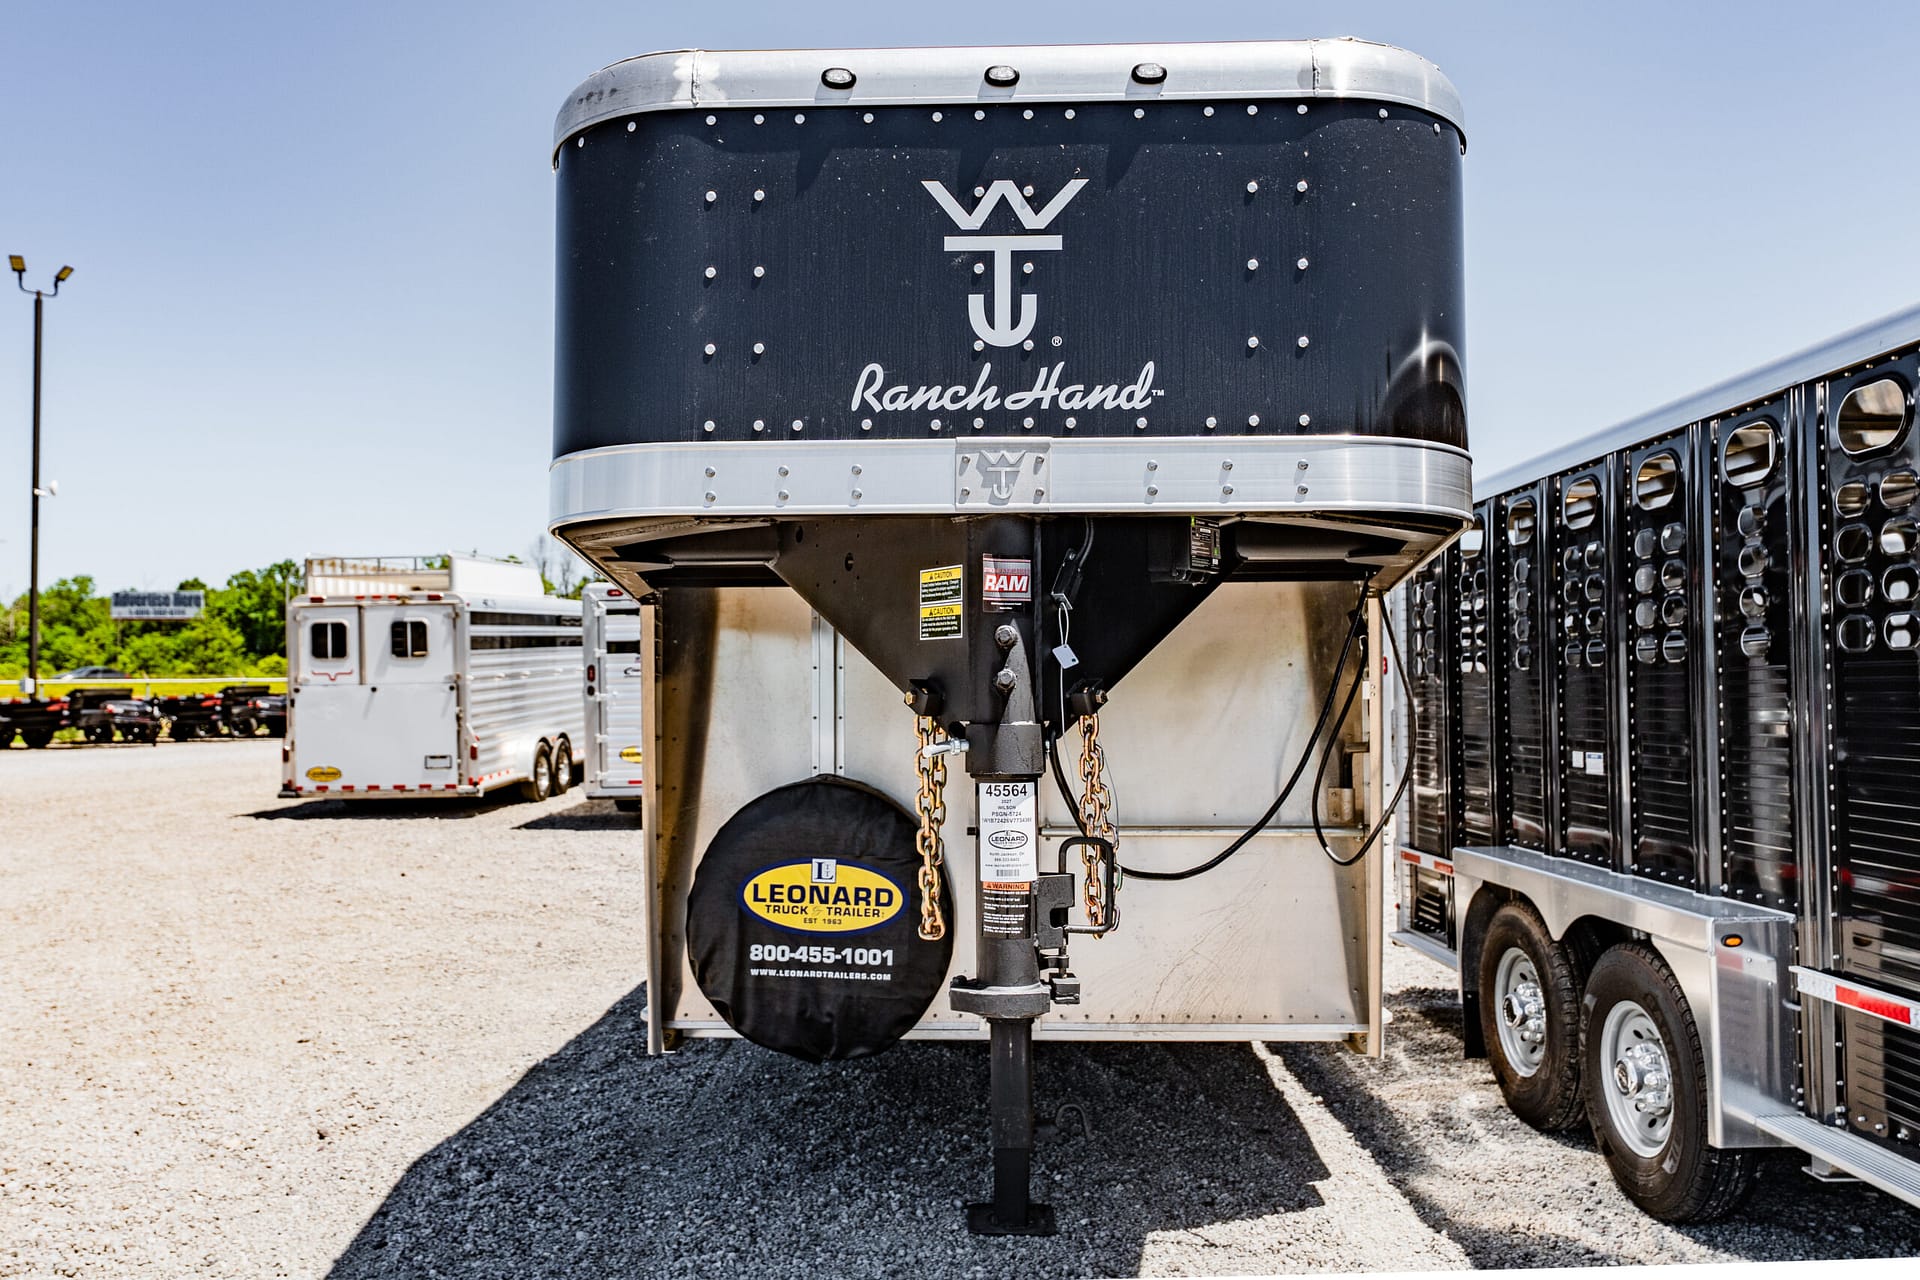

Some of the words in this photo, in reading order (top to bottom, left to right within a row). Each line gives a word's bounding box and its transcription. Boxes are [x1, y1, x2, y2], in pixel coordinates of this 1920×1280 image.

[851, 362, 1001, 413] Ranch
[1003, 361, 1155, 411] Hand
[934, 571, 953, 580] CAUTION
[984, 574, 1029, 592] RAM
[933, 606, 954, 616] CAUTION
[985, 784, 1028, 797] 45564
[992, 882, 1025, 890] WARNING
[752, 883, 894, 907] LEONARD
[765, 904, 809, 915] TRUCK
[826, 906, 881, 918] TRAILER
[803, 917, 818, 925] EST
[749, 944, 894, 966] 800-455-1001
[750, 968, 892, 981] WWW.LEONARDTRAILERS.COM
